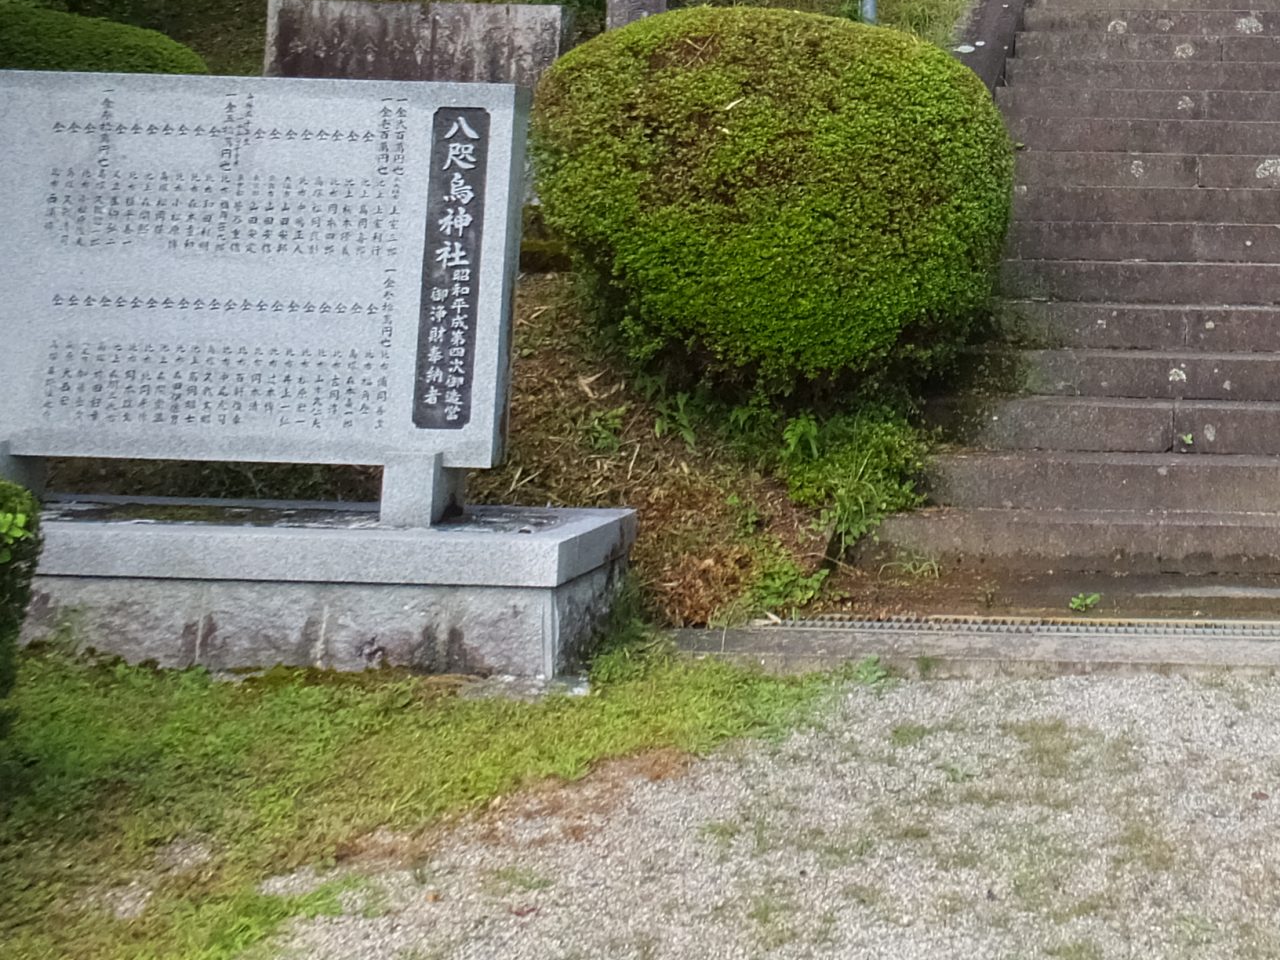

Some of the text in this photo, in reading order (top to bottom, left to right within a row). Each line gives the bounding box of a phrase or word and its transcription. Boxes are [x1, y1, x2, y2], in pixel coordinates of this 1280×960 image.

[436, 116, 481, 269] 八咫烏神社
[424, 286, 449, 405] 御浄財奉納者
[443, 269, 471, 421] 昭和平成第四次御造営
